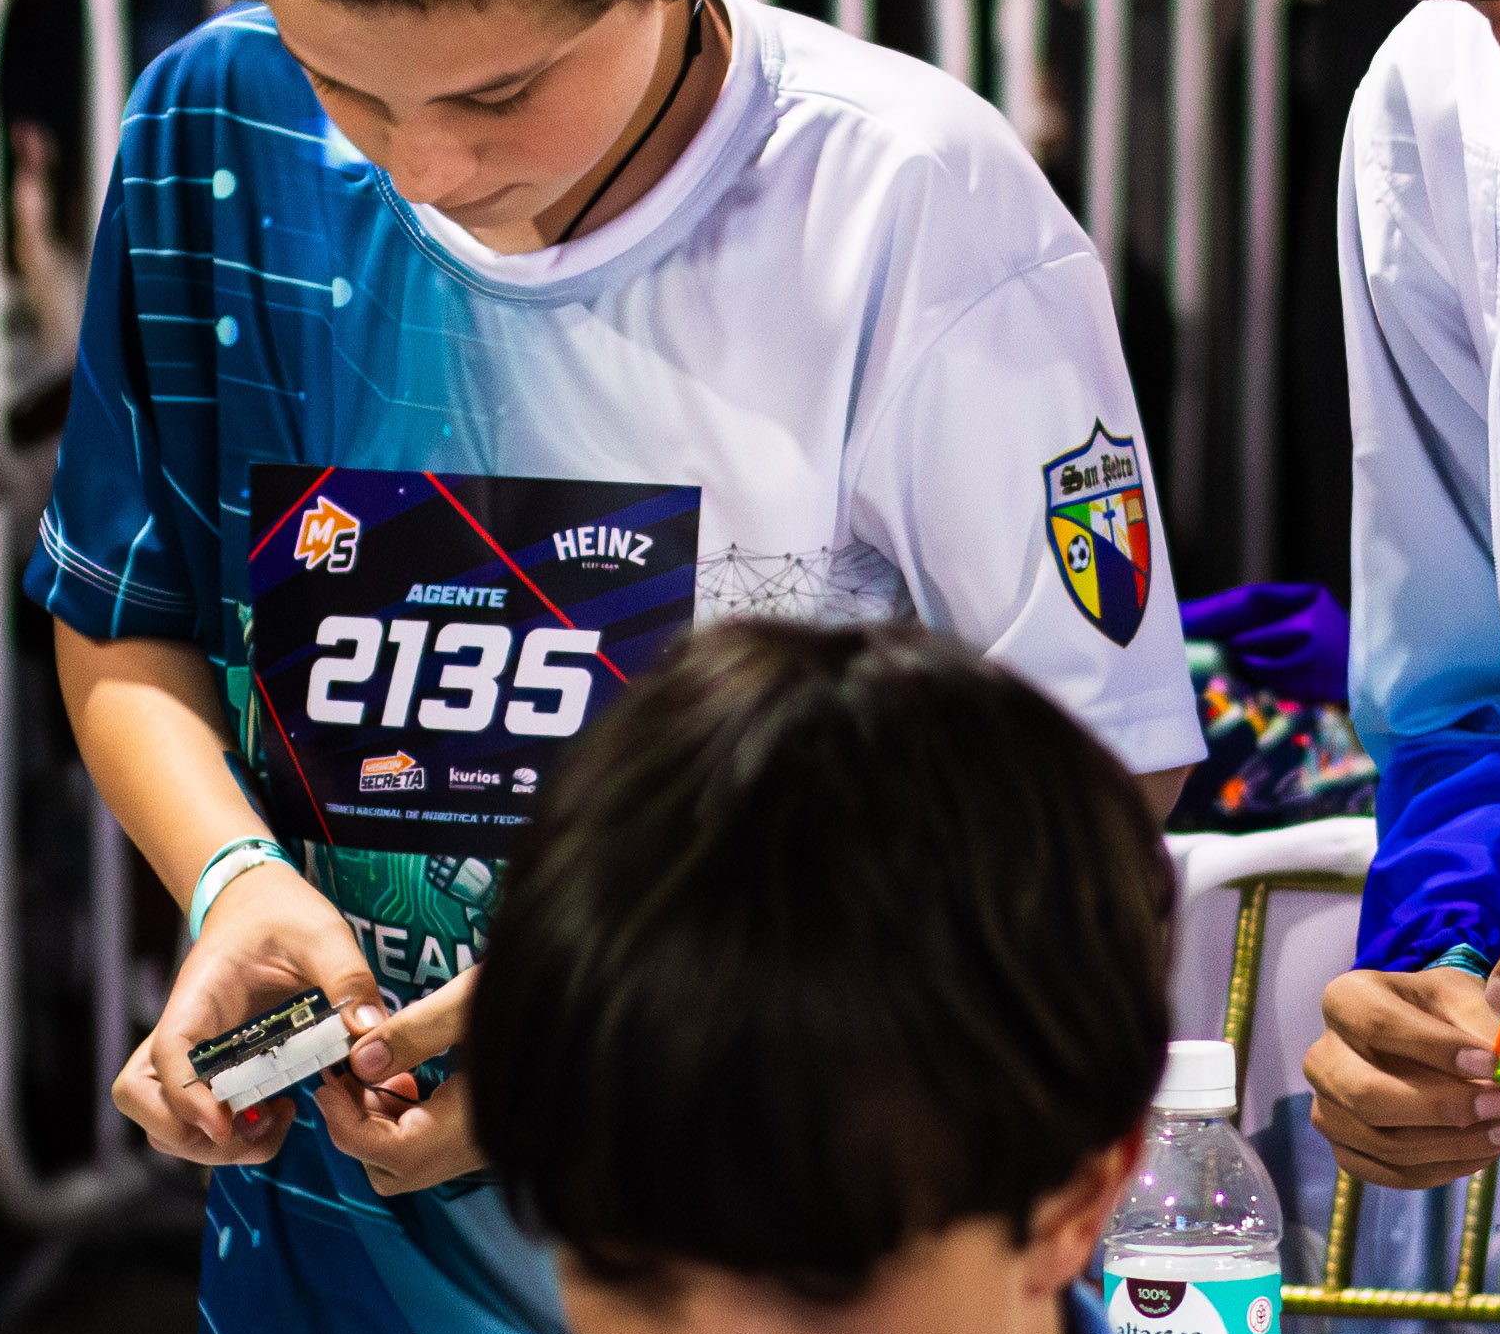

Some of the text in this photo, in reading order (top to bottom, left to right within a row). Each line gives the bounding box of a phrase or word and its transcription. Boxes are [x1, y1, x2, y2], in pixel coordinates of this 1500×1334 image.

[552, 525, 655, 566] HEINZ
[405, 582, 508, 608] AGENTE
[306, 615, 601, 737] 2135
[361, 770, 424, 789] SECRETA
[449, 767, 501, 785] kurios
[482, 814, 491, 823] Y
[1137, 1287, 1171, 1301] 100%
